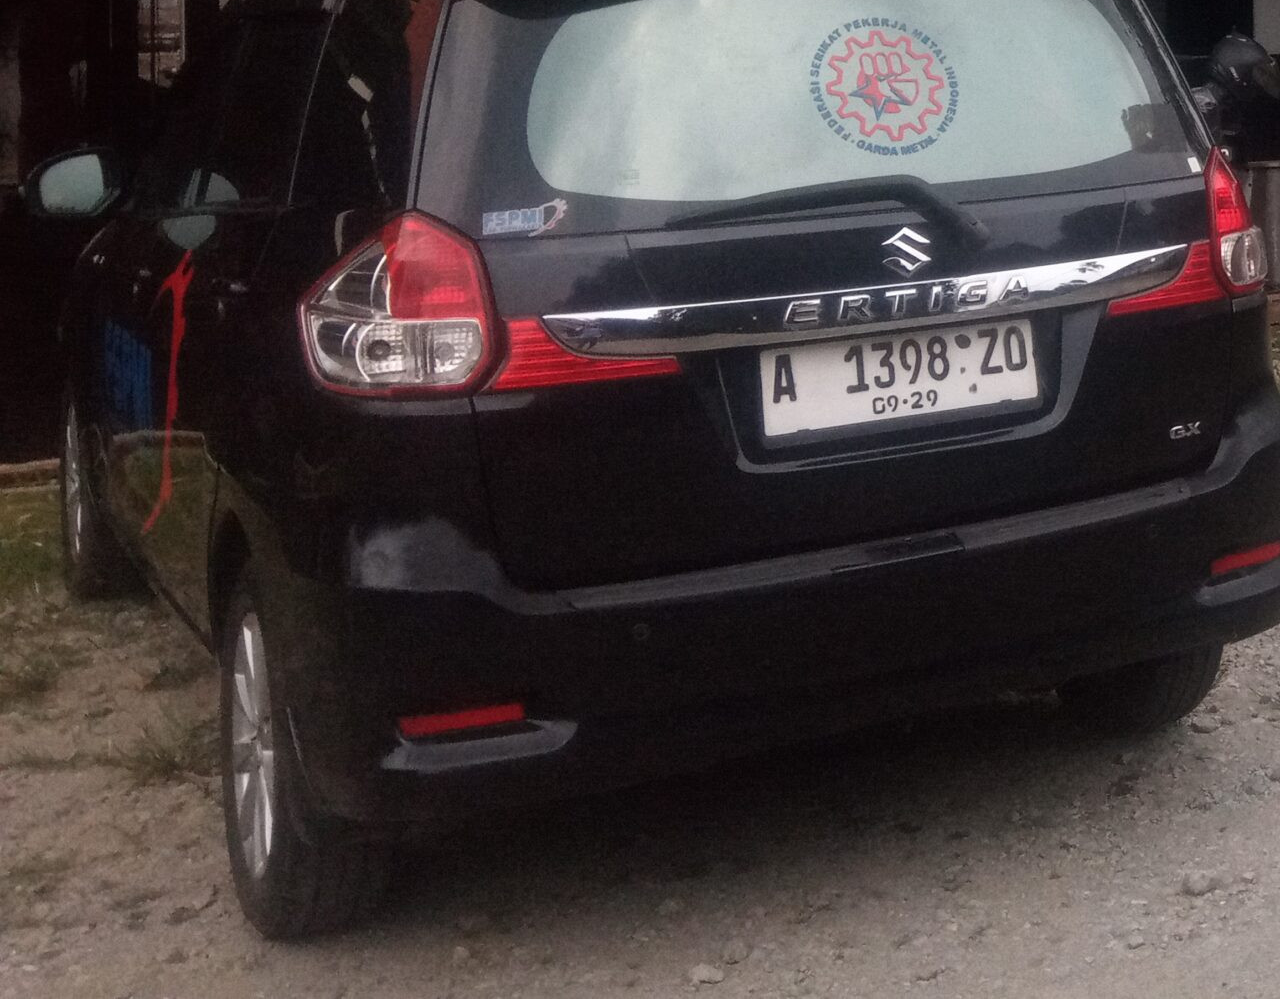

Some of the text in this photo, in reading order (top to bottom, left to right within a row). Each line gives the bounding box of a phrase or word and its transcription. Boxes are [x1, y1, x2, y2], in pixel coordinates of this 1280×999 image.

[809, 17, 960, 142] FEDERASI SERIKAT PEKERJA METAL INDONESIA
[856, 139, 900, 157] GARDA
[783, 275, 1030, 329] ERTIGA
[773, 325, 1028, 403] A 1398 ZO
[1169, 421, 1201, 440] GX
